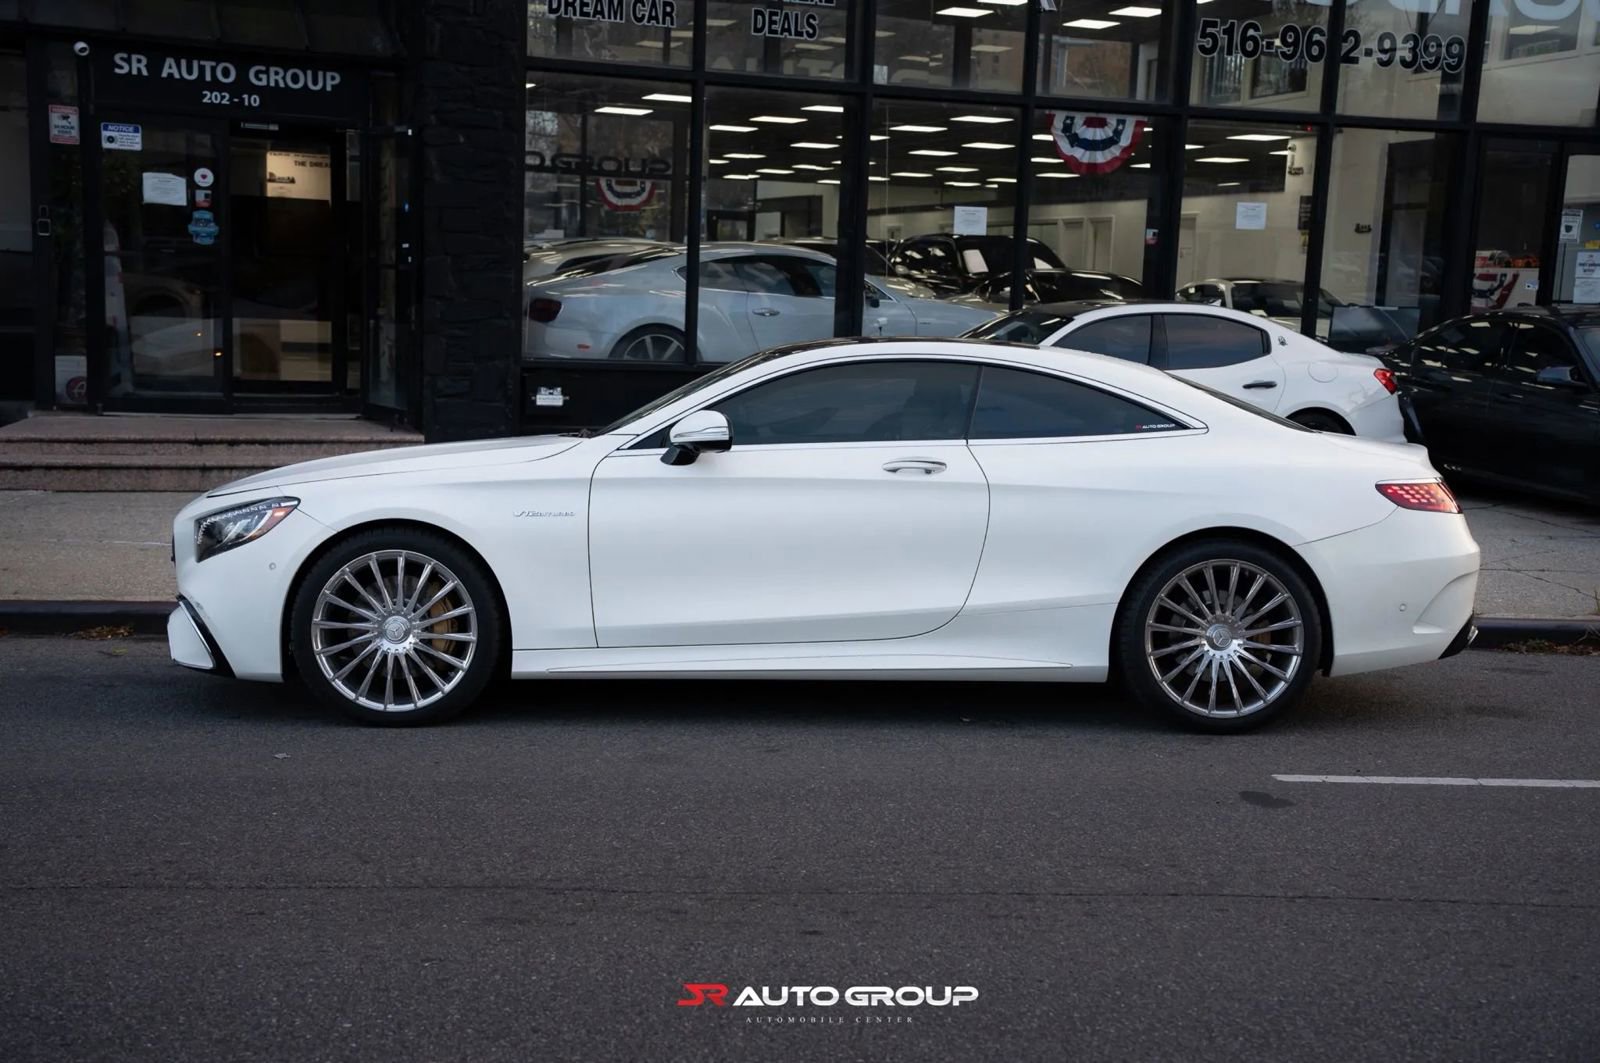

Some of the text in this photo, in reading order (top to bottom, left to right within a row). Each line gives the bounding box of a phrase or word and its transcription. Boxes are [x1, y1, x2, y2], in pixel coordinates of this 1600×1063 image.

[547, 0, 677, 27] DREAM CAR
[751, 8, 819, 40] DEALS
[113, 52, 341, 91] SR AUTO GROUP
[108, 124, 134, 133] NOTICE
